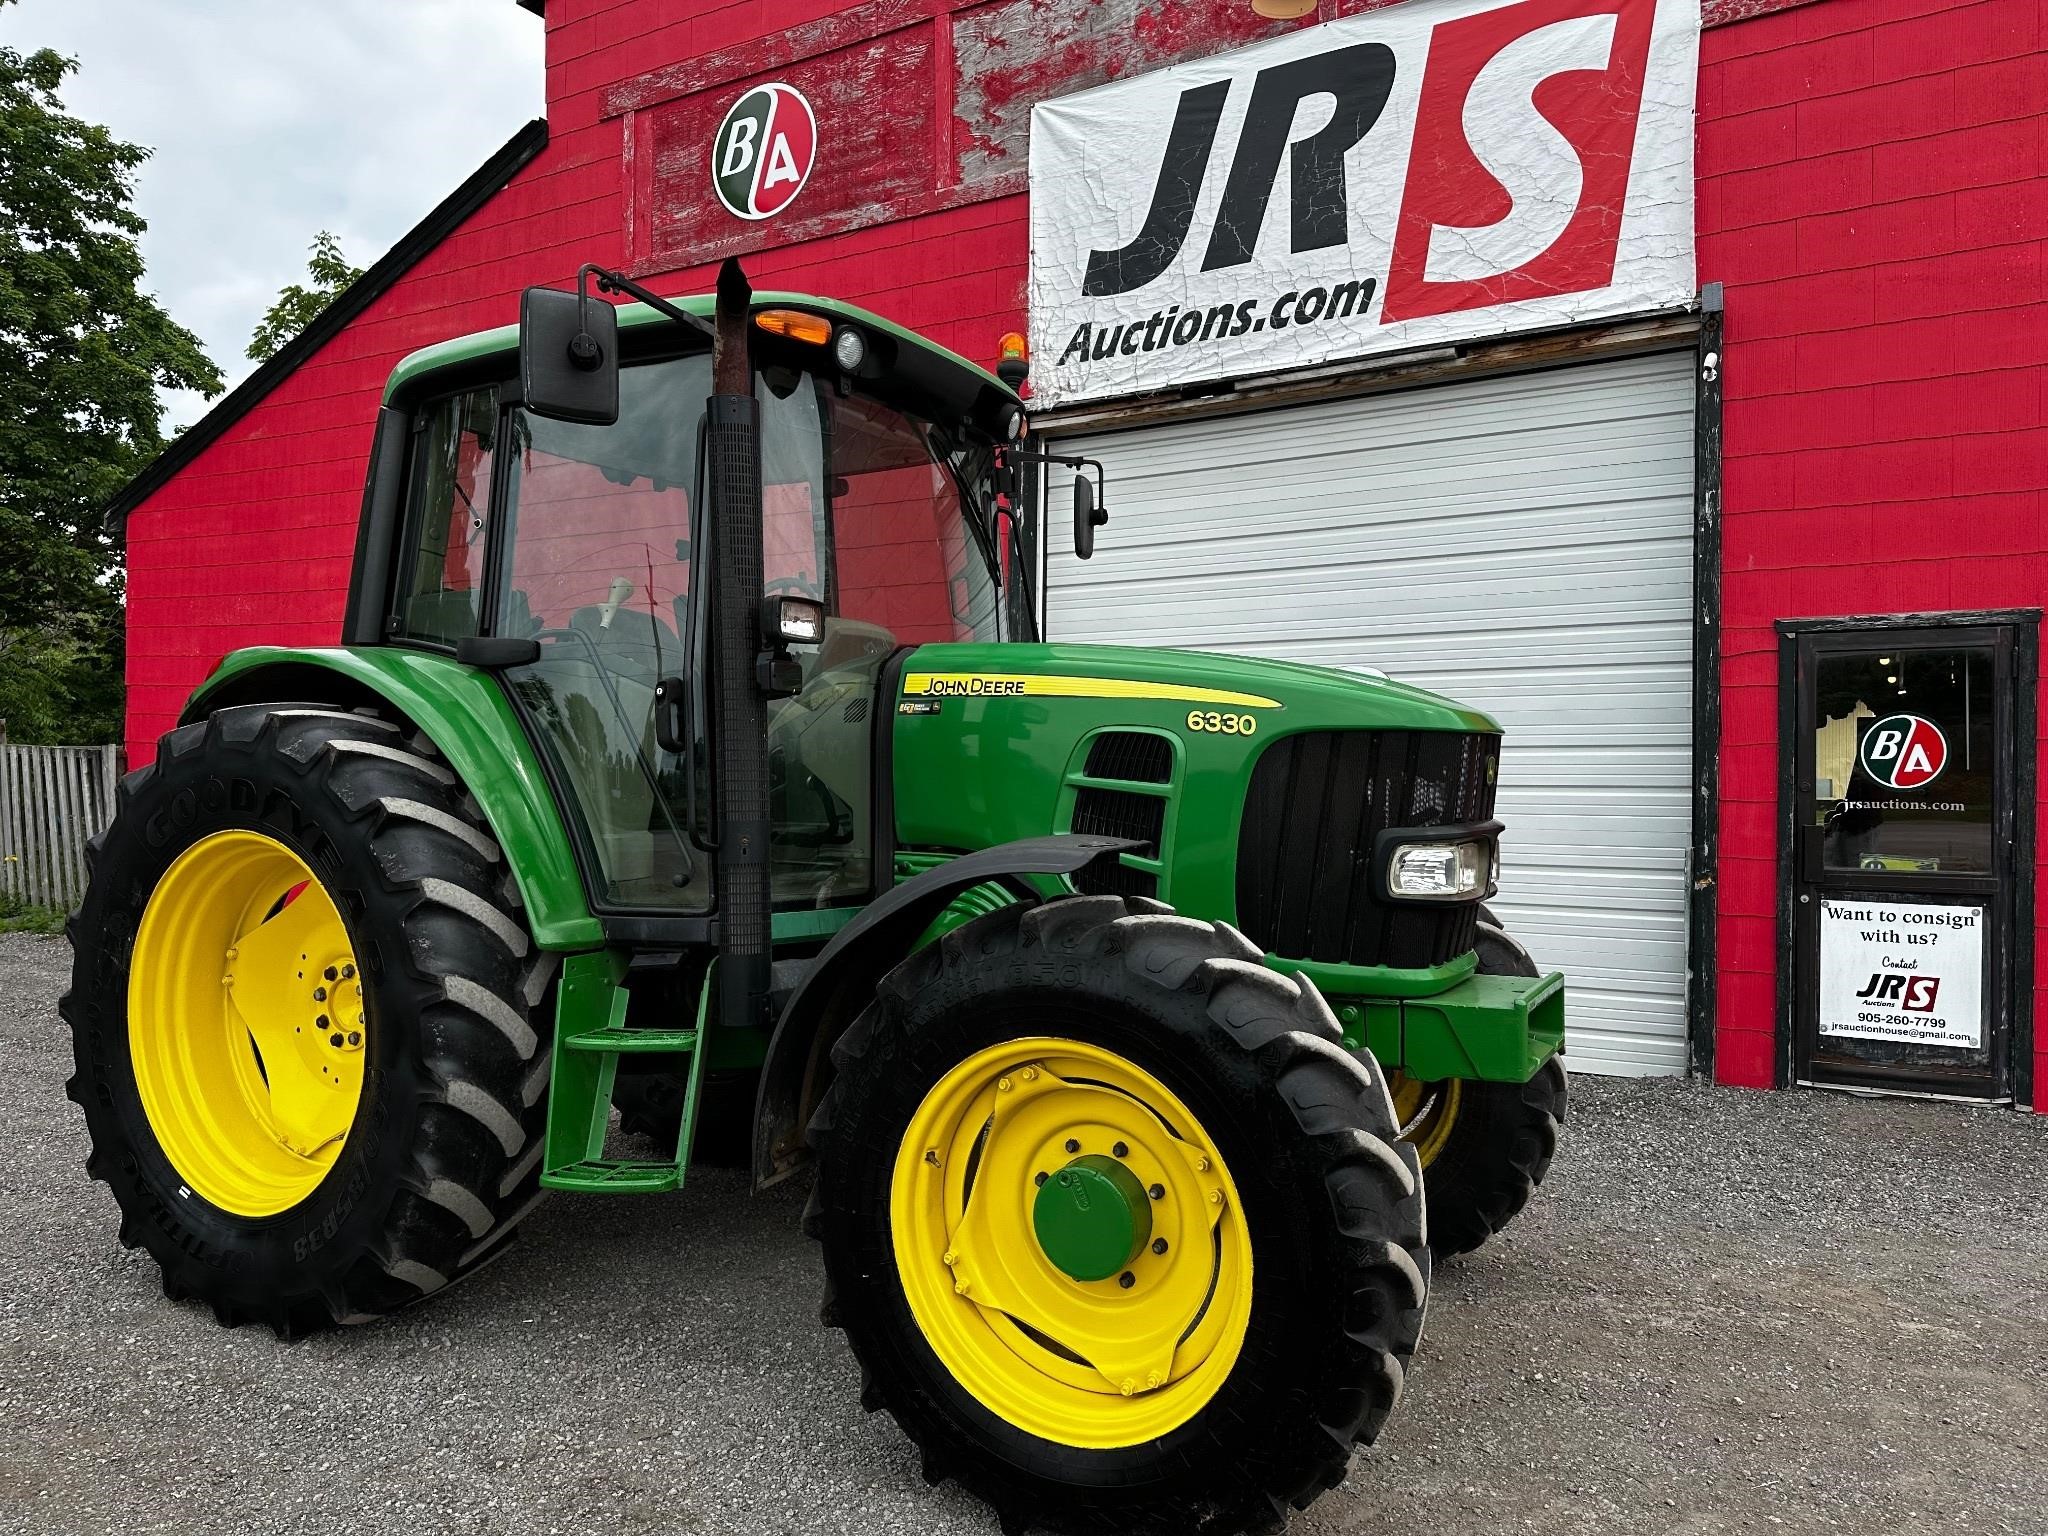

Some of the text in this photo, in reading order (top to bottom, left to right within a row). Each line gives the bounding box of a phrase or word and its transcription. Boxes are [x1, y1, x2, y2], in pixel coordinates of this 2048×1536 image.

[1081, 12, 1618, 297] JRS
[1057, 276, 1376, 366] Auctions.com
[923, 677, 1025, 695] JOHN DEERE
[1186, 710, 1257, 737] 6330
[1844, 798, 1965, 812] jrsauctions.com
[1827, 907, 1975, 930] Want to consign
[1860, 929, 1938, 946] with us?
[1881, 956, 1918, 970] Contact
[1855, 973, 1936, 1009] JRS
[1862, 999, 1896, 1008] Auctions
[1857, 1012, 1946, 1029] 905-260-7799
[1831, 1021, 1971, 1042] jrsauctionhouse@gmail.com
